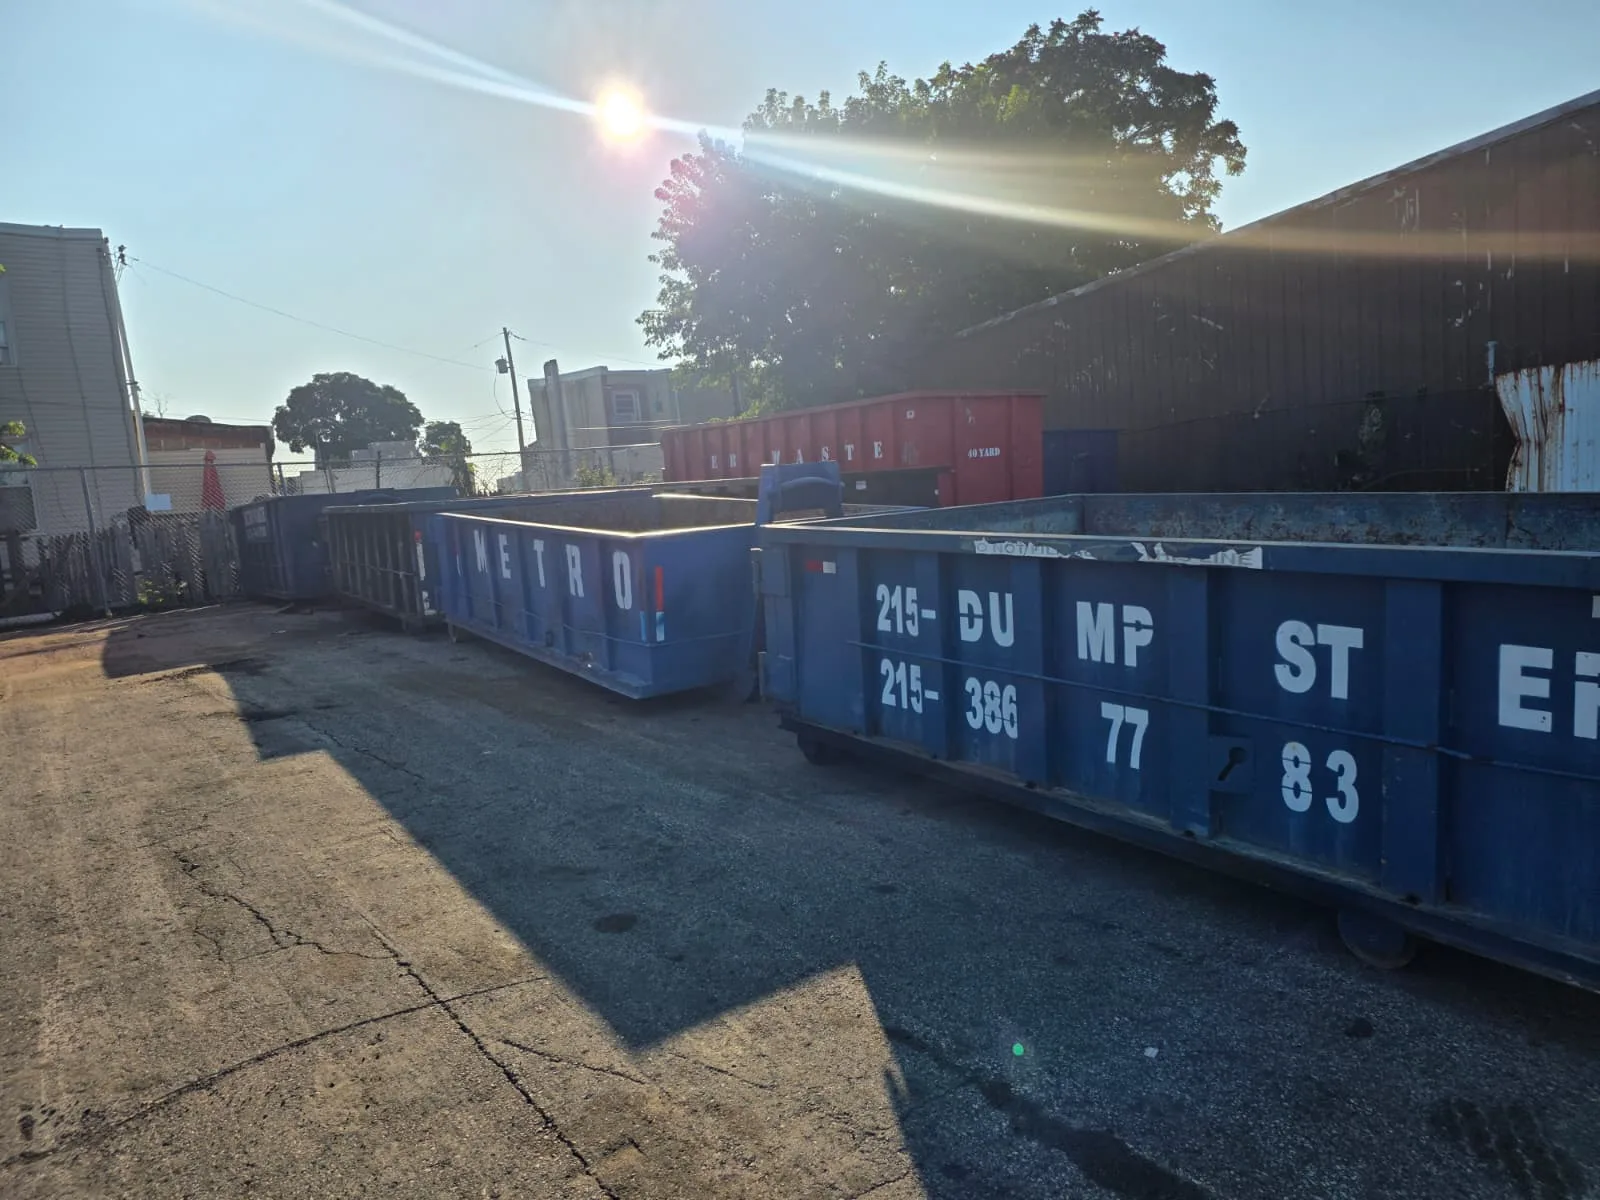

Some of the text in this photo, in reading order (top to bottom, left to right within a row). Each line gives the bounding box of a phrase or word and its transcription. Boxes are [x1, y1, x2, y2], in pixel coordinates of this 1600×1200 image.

[978, 447, 1001, 458] YARD
[473, 529, 634, 610] METRO
[876, 584, 936, 637] 215-
[880, 658, 939, 714] 215-
[965, 677, 1018, 739] 386
